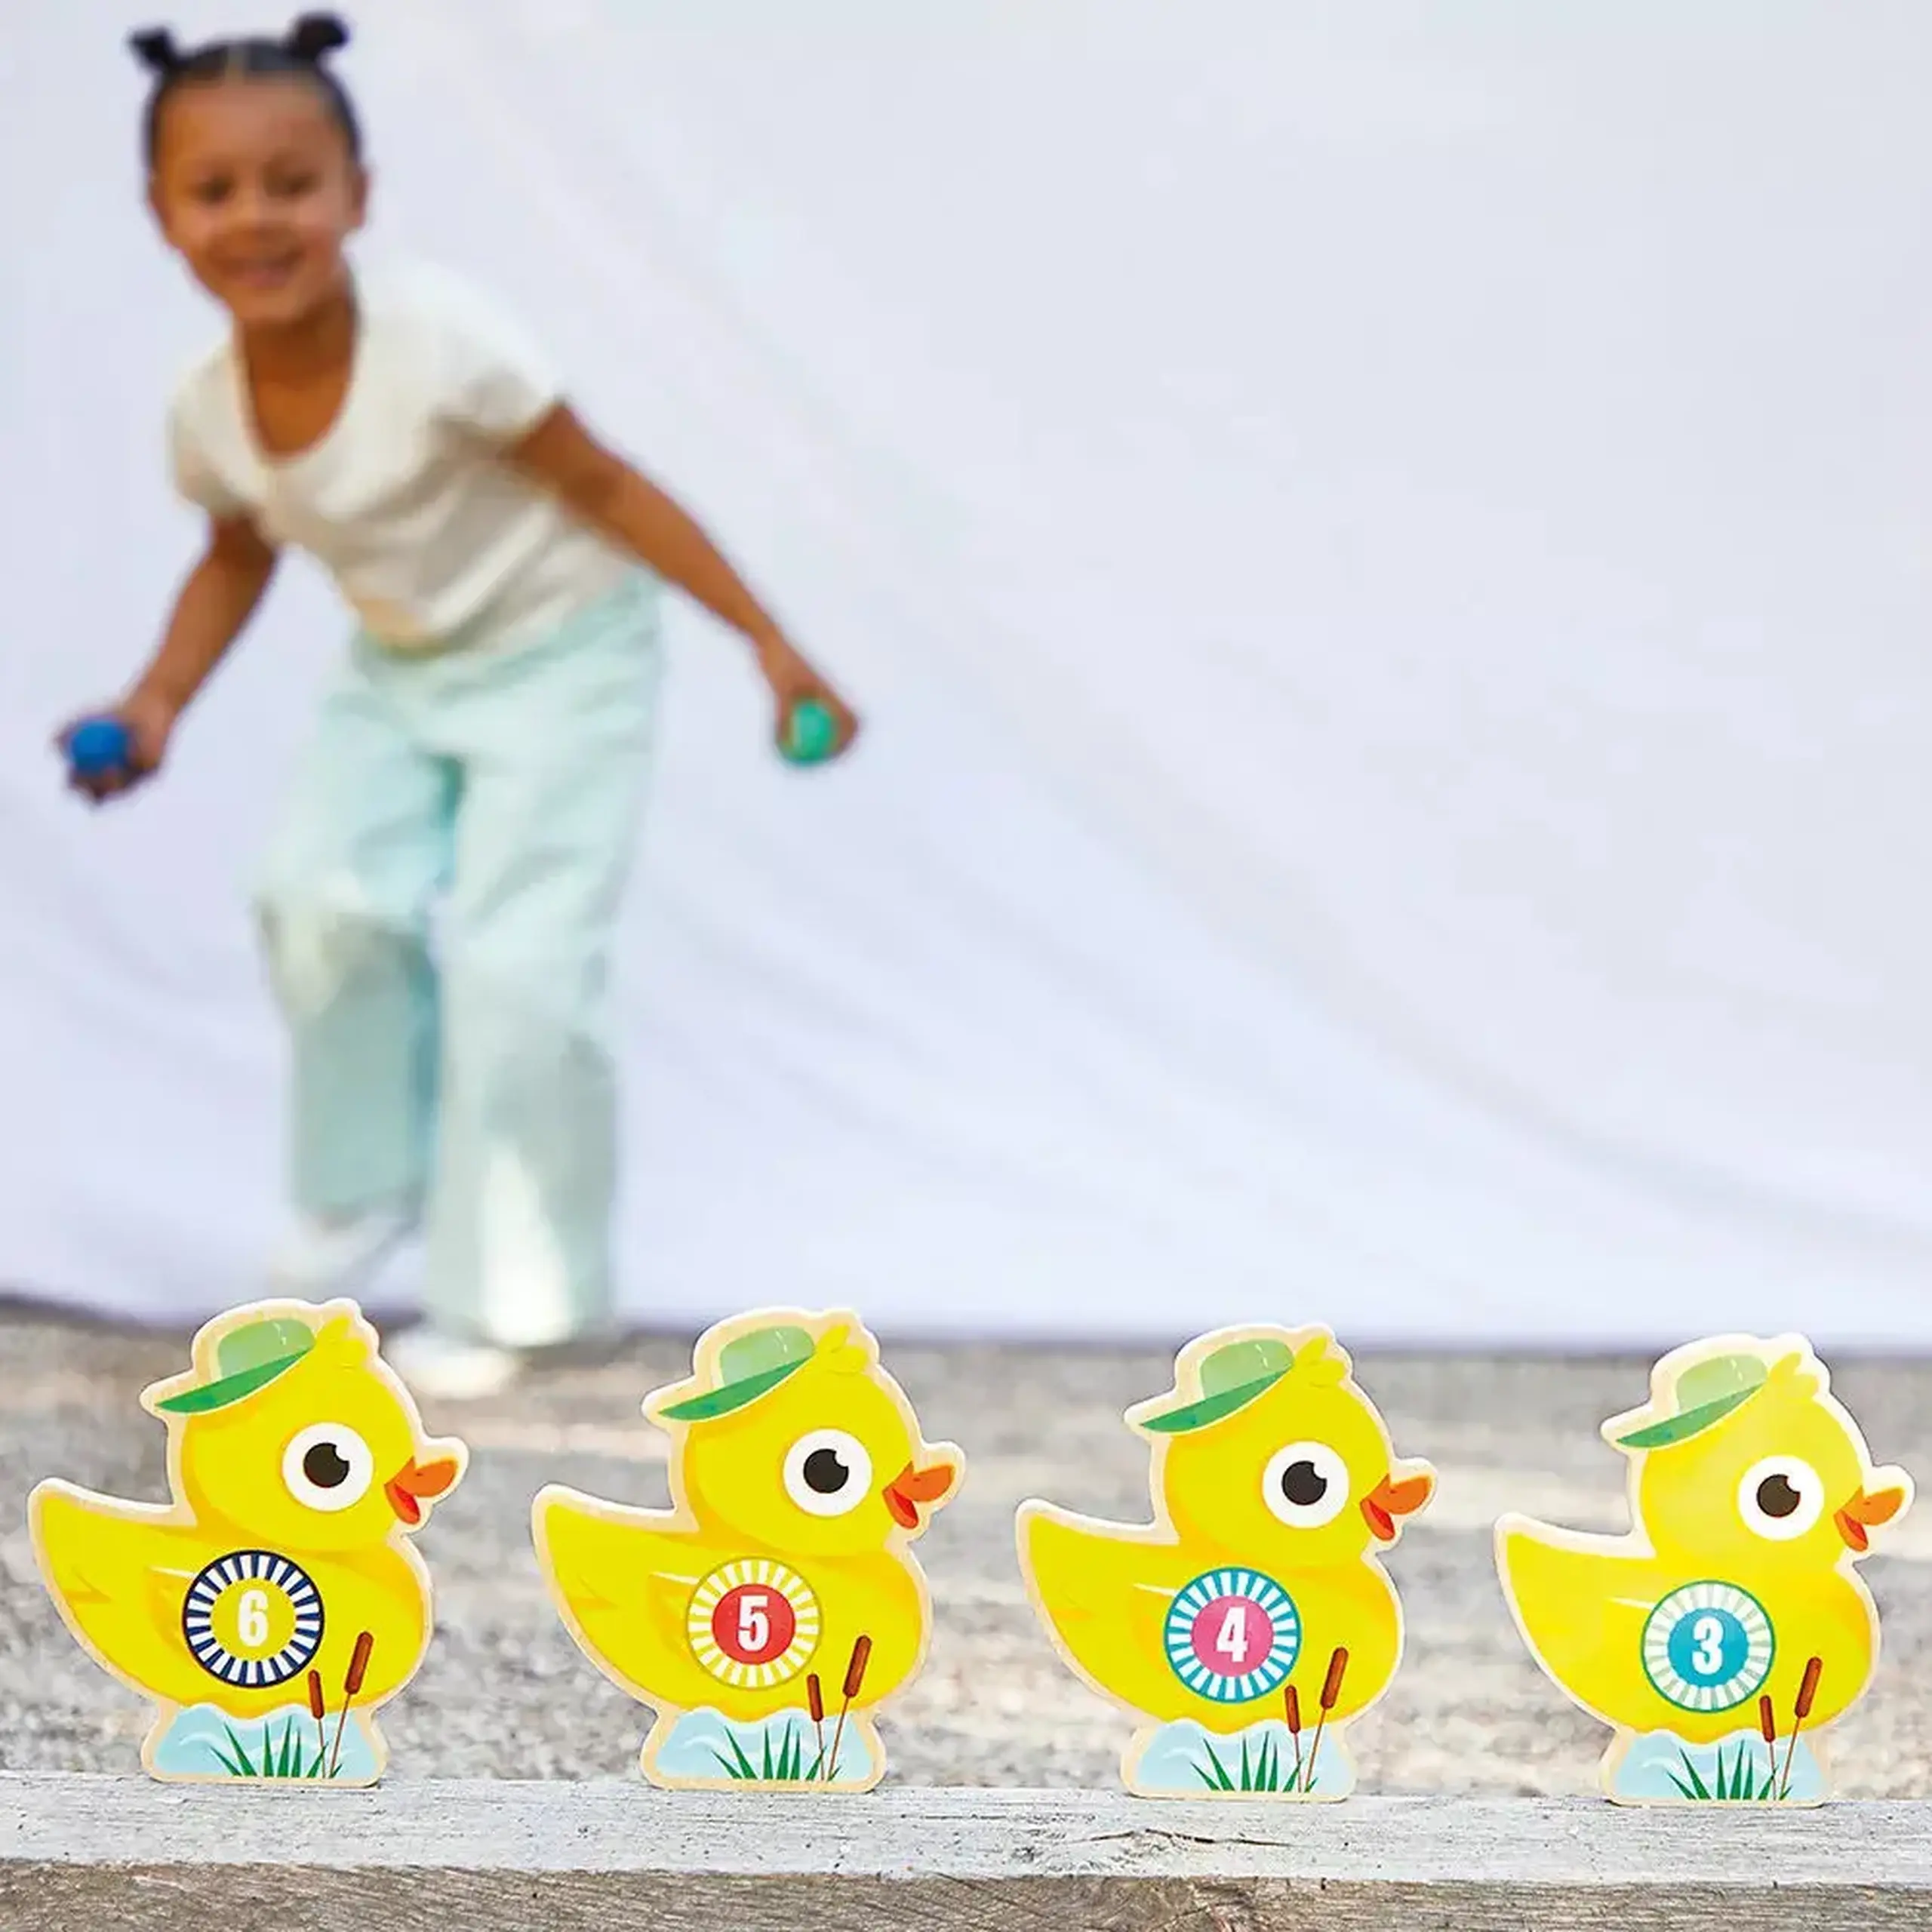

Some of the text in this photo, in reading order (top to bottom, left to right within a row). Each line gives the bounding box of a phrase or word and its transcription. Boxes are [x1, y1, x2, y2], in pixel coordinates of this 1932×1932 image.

[238, 1590, 268, 1646] 6
[737, 1595, 768, 1651] 5
[1216, 1606, 1247, 1663] 4
[1692, 1617, 1724, 1674] 3
